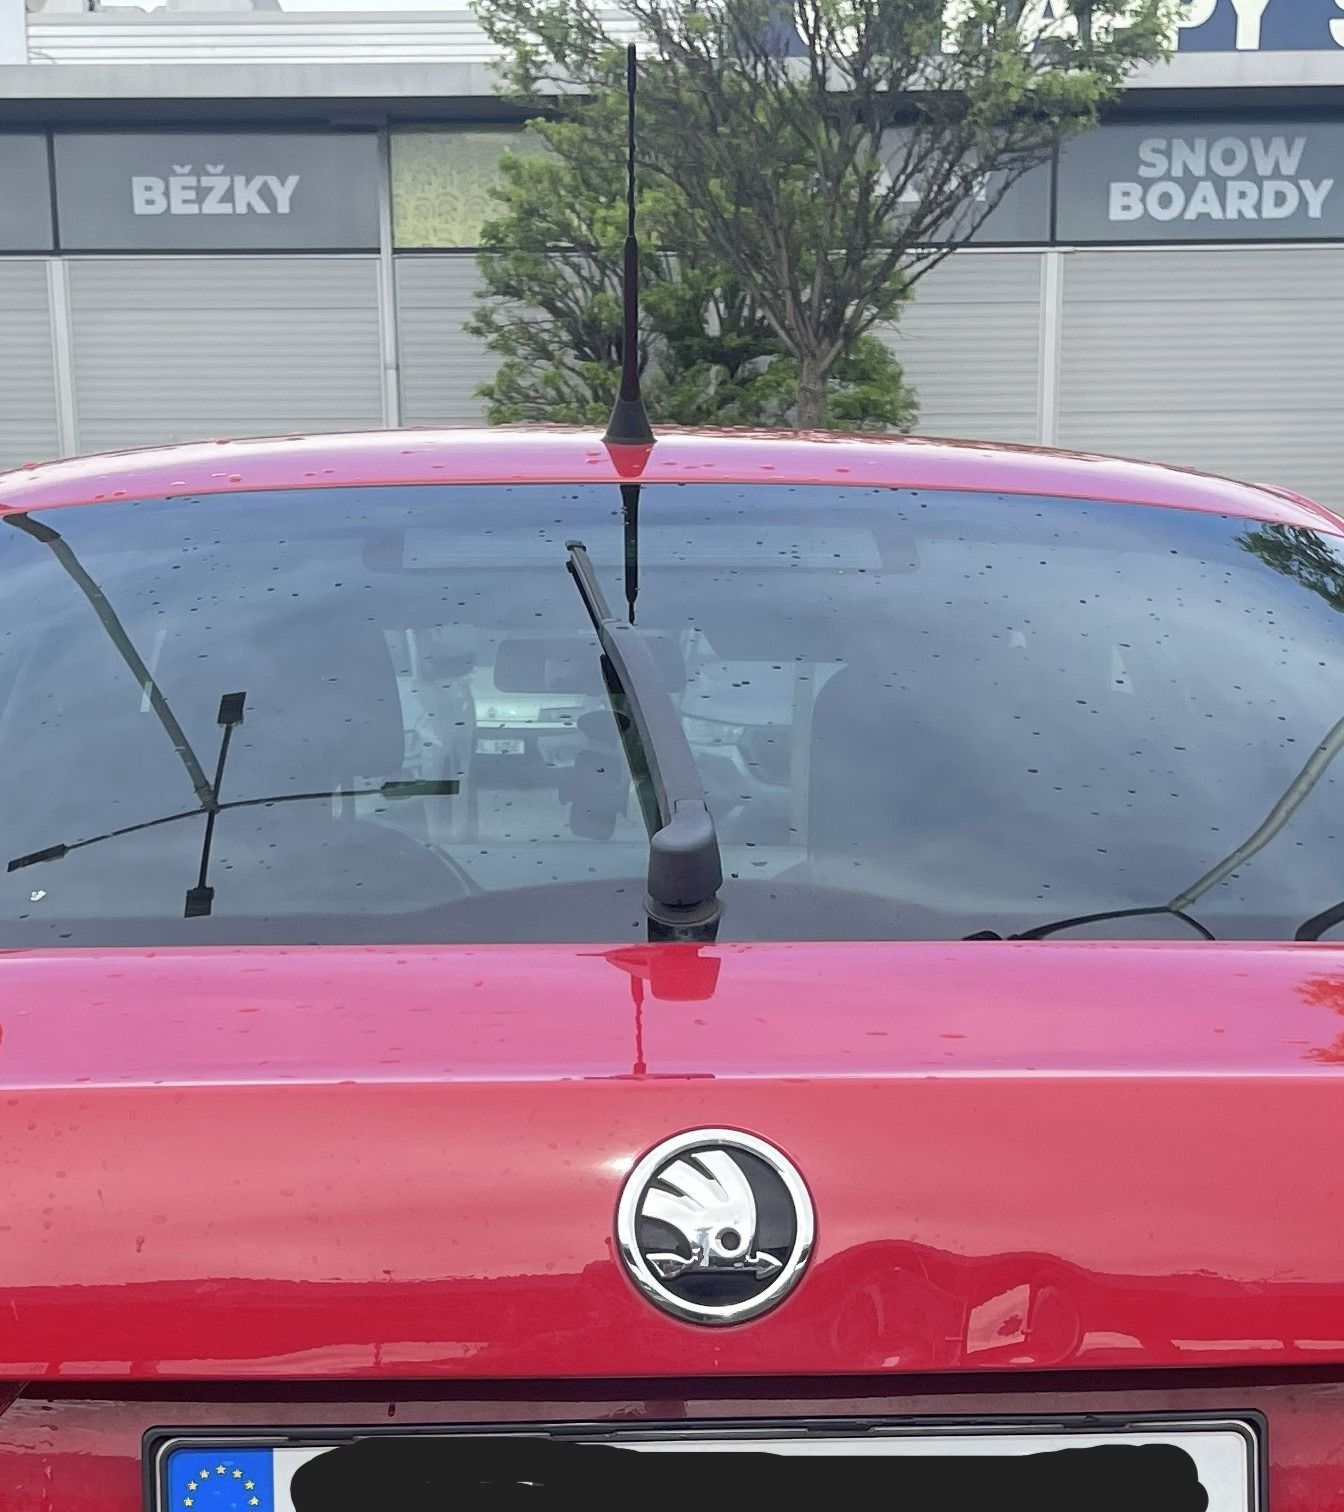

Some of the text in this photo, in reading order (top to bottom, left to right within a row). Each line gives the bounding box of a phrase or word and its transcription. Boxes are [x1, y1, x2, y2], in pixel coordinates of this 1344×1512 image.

[1137, 136, 1307, 178] SNOW
[131, 164, 300, 215] BĚŽKY
[1108, 179, 1335, 221] BOARDY
